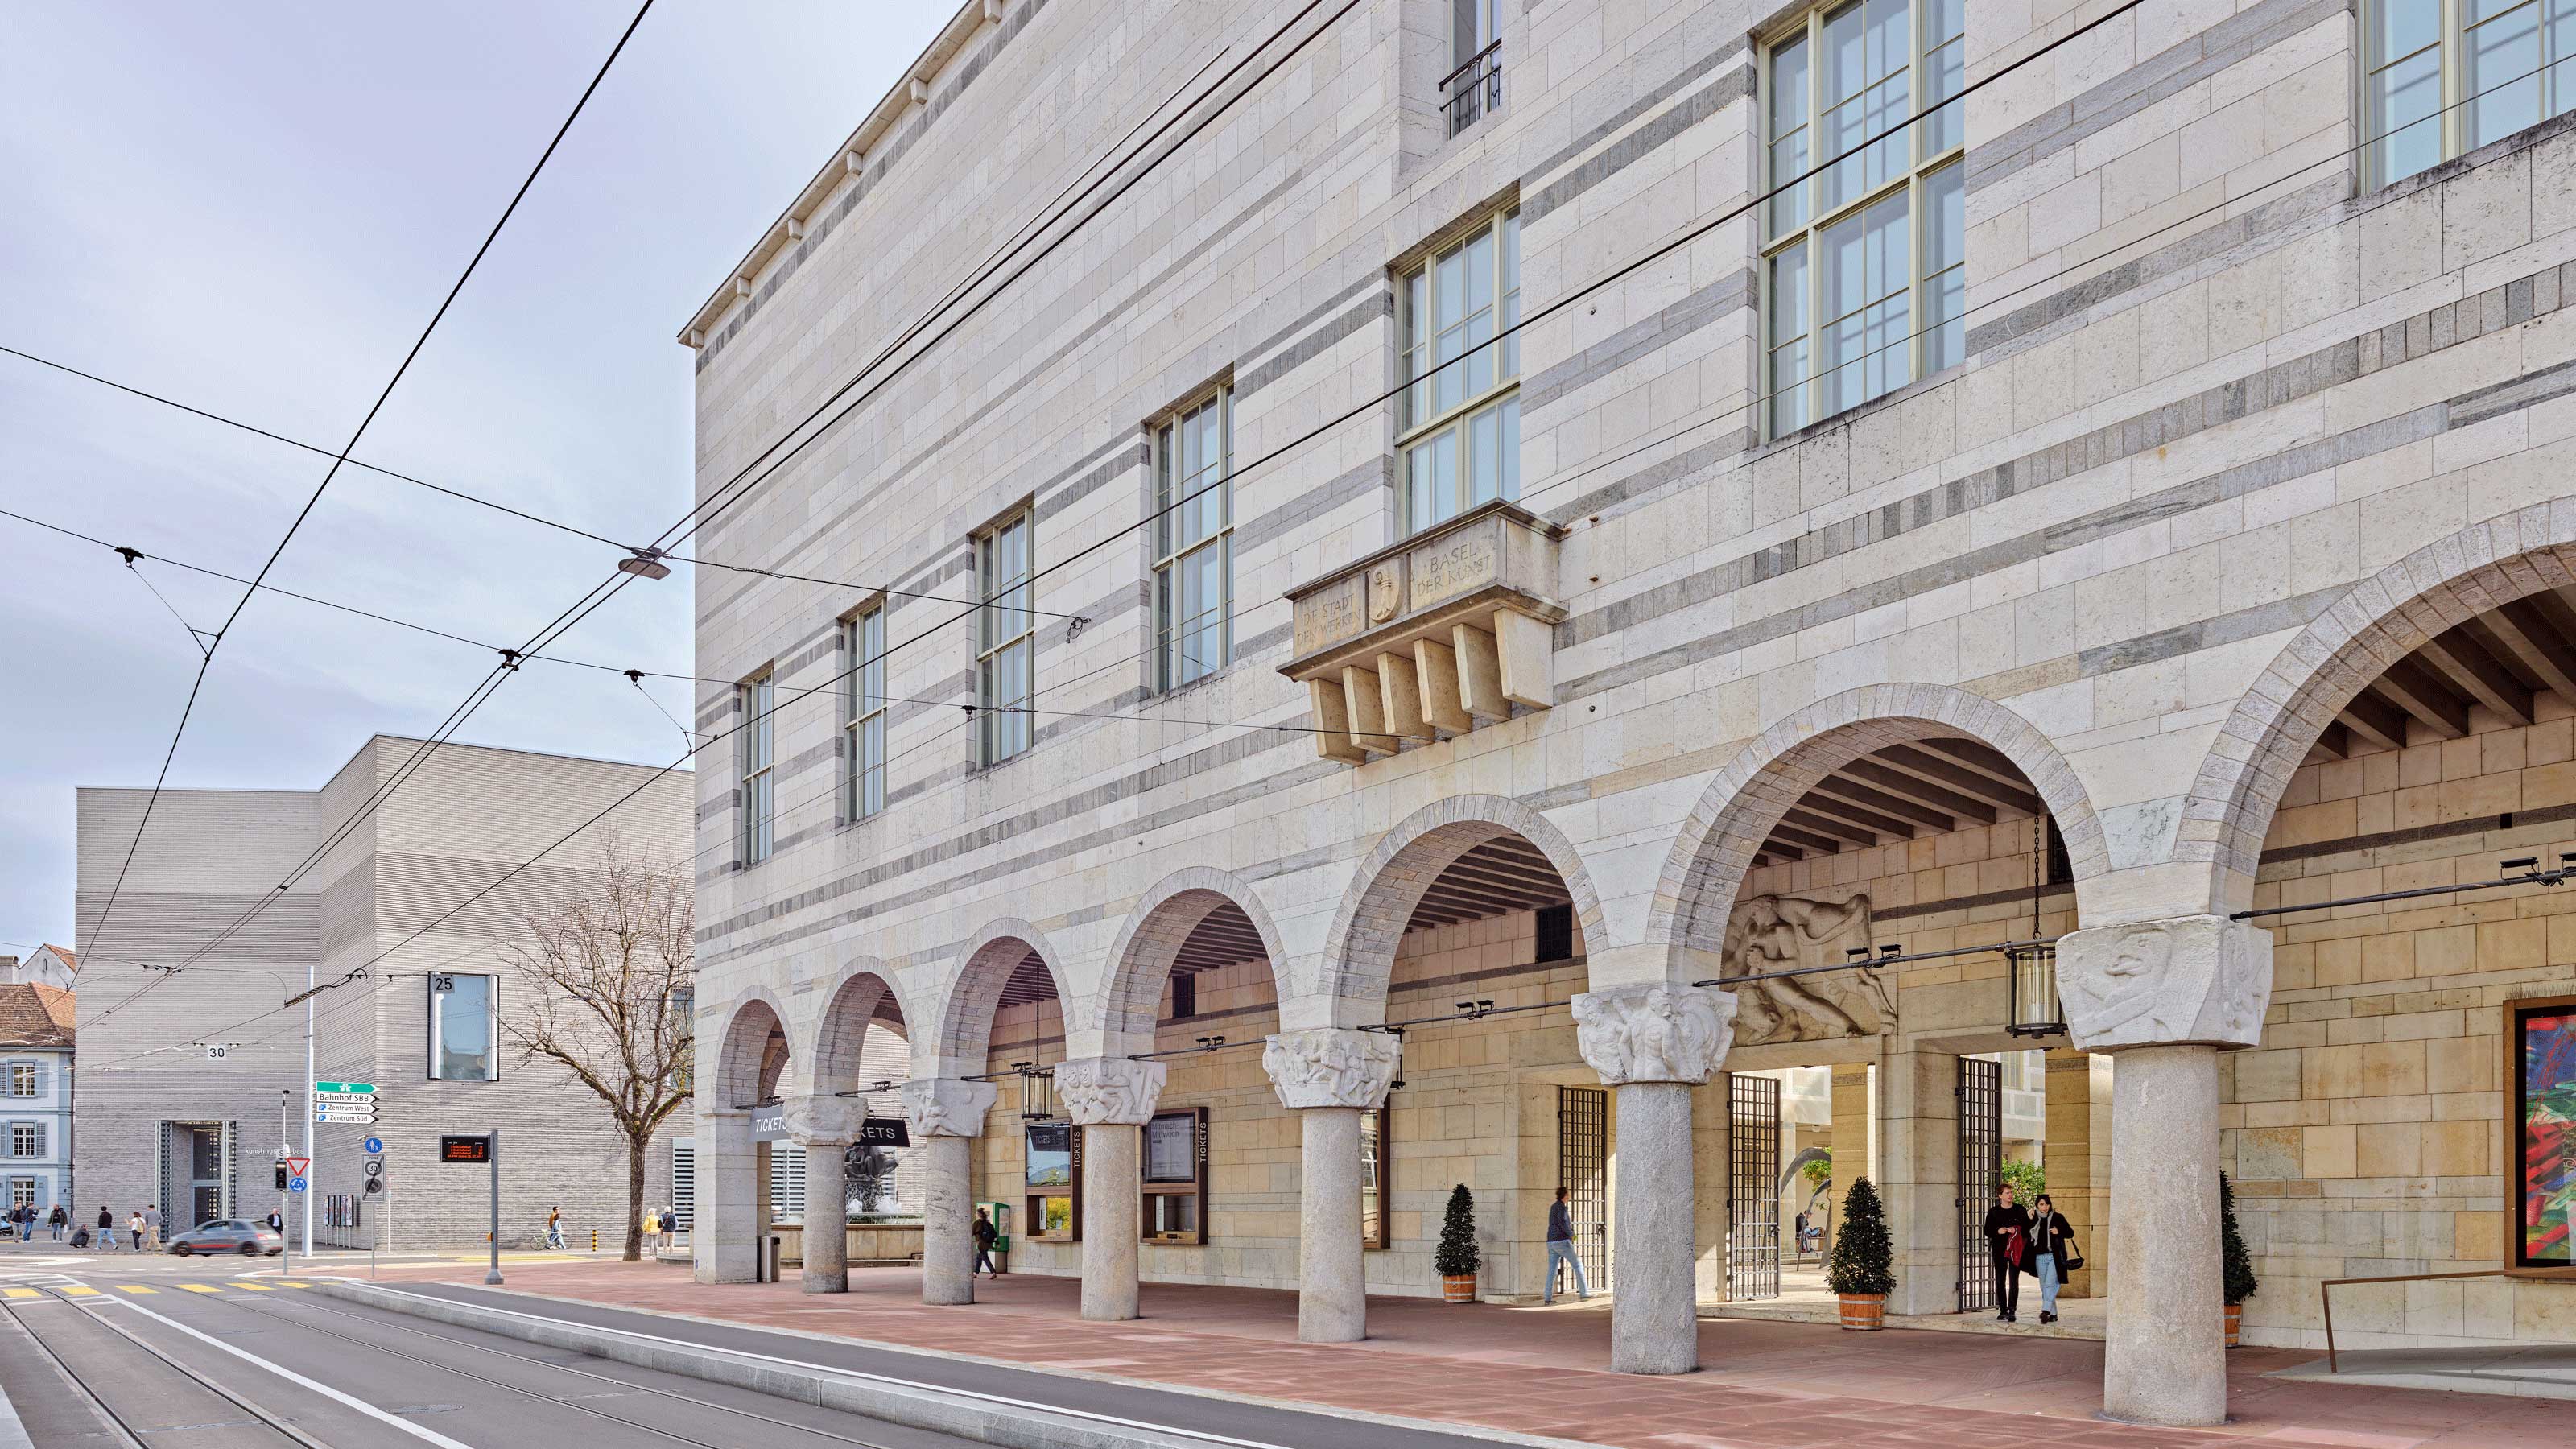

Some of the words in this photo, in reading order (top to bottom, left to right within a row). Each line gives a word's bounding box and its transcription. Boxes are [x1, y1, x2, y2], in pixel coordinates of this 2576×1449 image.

[1303, 609, 1318, 626] DIE
[1323, 593, 1354, 618] STADT
[1430, 542, 1476, 573] BASEL
[1316, 608, 1362, 633] WERKEN
[1418, 576, 1443, 597] DER
[1448, 555, 1491, 585] KUNST
[436, 977, 452, 991] 25
[209, 1047, 225, 1058] 30
[320, 1093, 352, 1101] Bahnhof
[861, 1126, 895, 1139] KETS
[1151, 1130, 1179, 1139] Mittwoch
